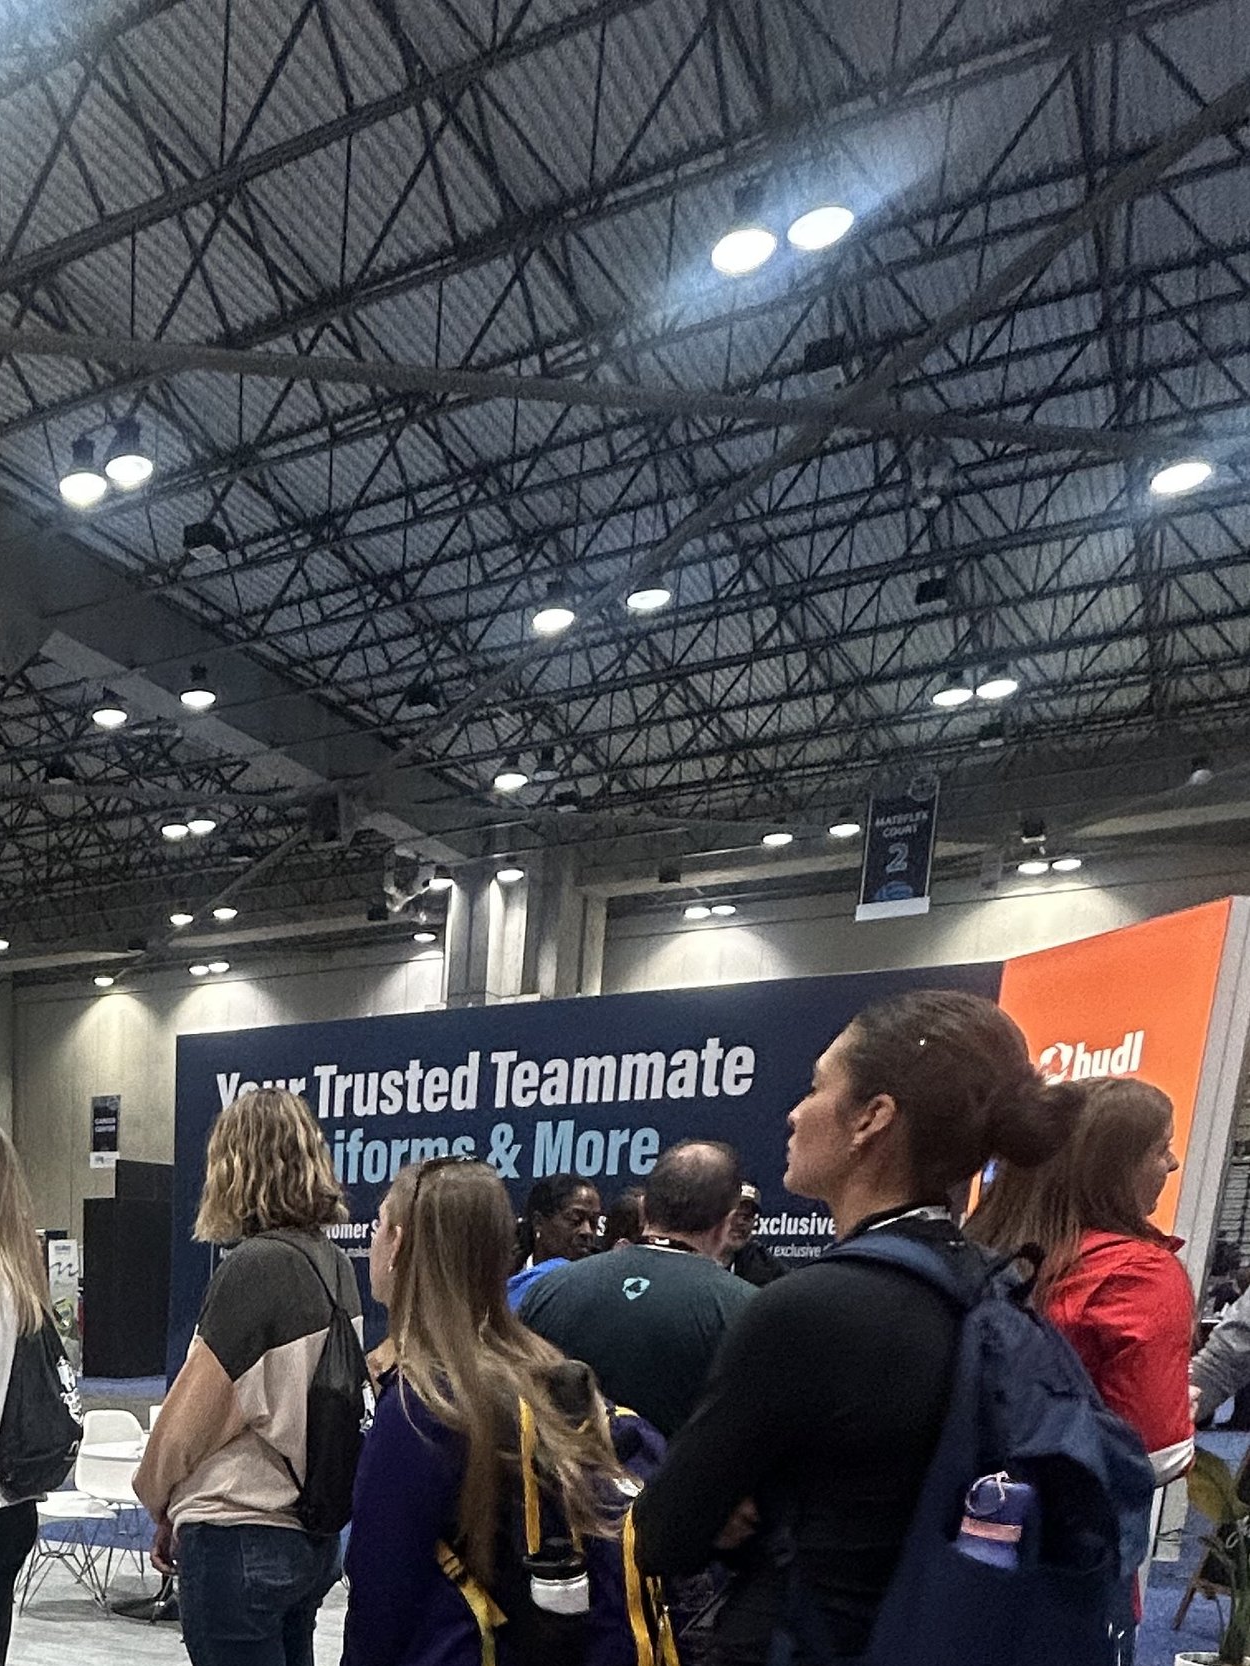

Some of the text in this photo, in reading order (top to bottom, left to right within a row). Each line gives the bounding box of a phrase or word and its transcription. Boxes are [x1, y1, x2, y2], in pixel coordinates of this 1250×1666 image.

[882, 822, 918, 838] COURT
[885, 842, 909, 874] 2
[314, 1051, 480, 1119] Trusted
[491, 1037, 755, 1109] Teammate
[1071, 1029, 1145, 1081] hudl
[486, 1122, 522, 1179] &
[532, 1119, 660, 1179] More
